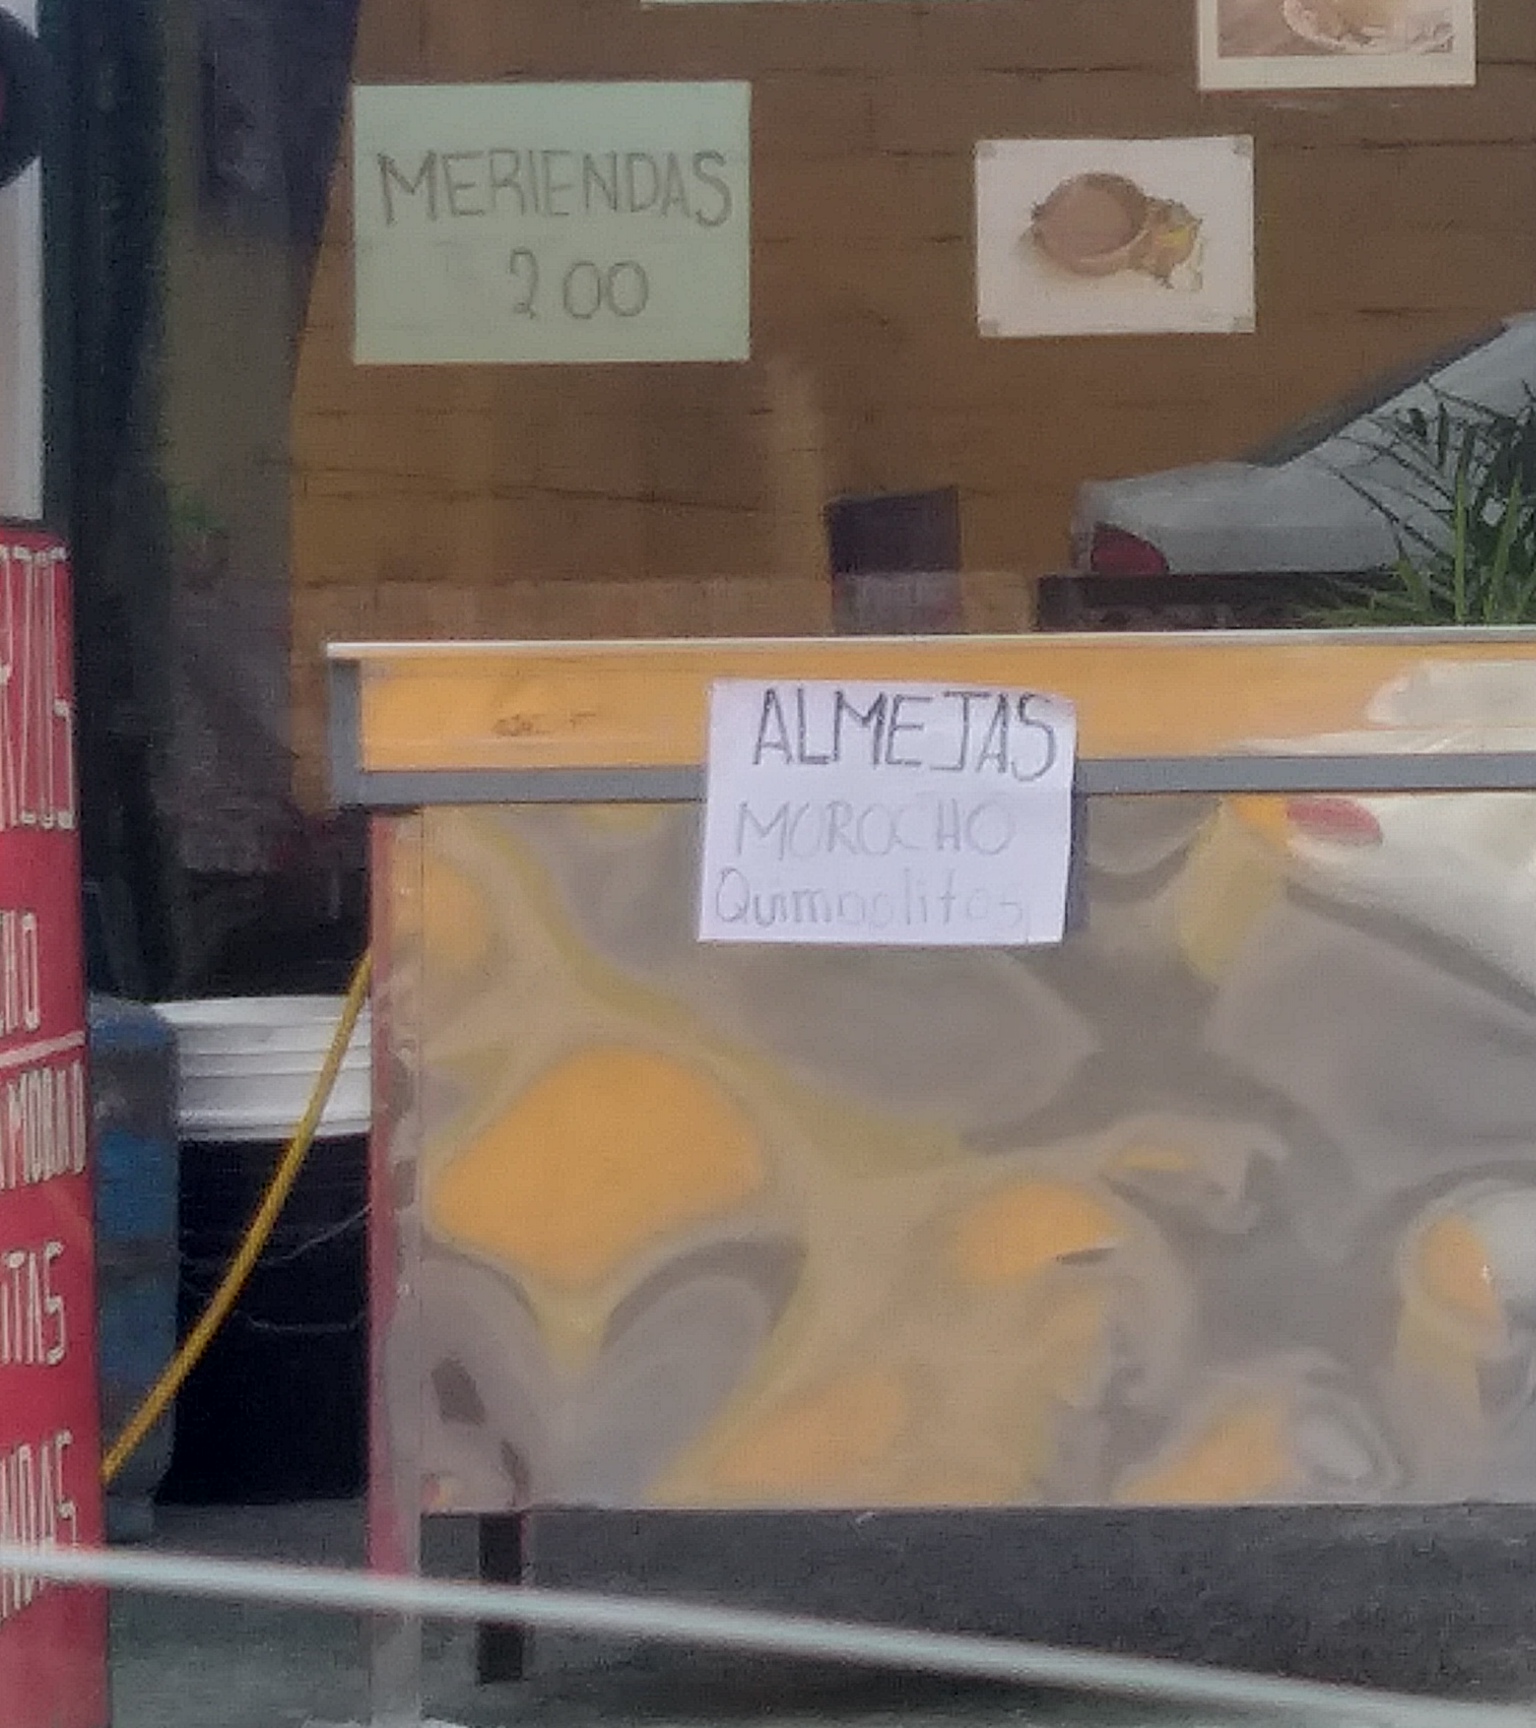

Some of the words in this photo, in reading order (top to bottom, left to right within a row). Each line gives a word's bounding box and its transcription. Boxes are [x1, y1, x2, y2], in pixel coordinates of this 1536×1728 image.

[376, 149, 733, 227] MERIENDAS
[751, 687, 1058, 782] ALMEJAS
[735, 797, 1017, 861] MOROCHO
